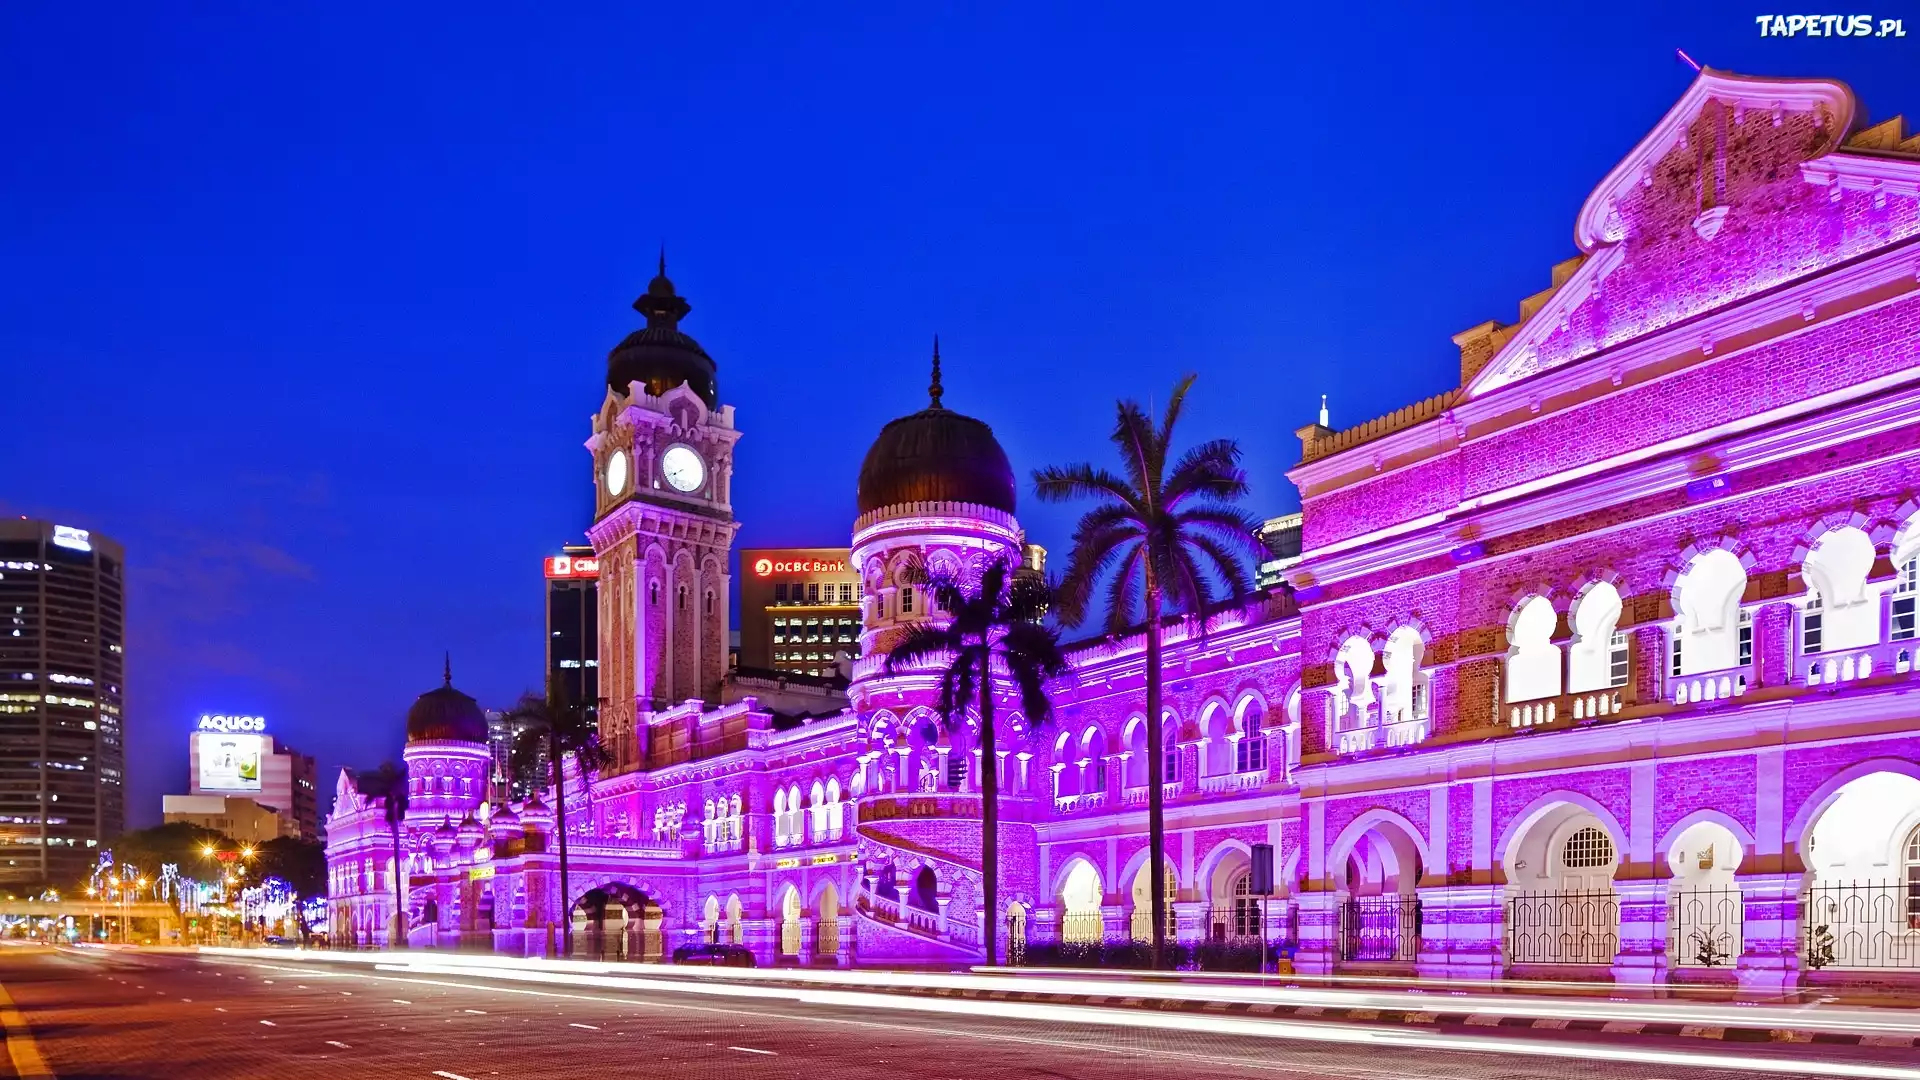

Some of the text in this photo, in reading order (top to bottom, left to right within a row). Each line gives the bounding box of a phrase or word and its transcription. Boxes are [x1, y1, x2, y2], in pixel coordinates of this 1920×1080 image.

[774, 560, 845, 573] OCBC Bank
[198, 714, 266, 733] AQUOS
